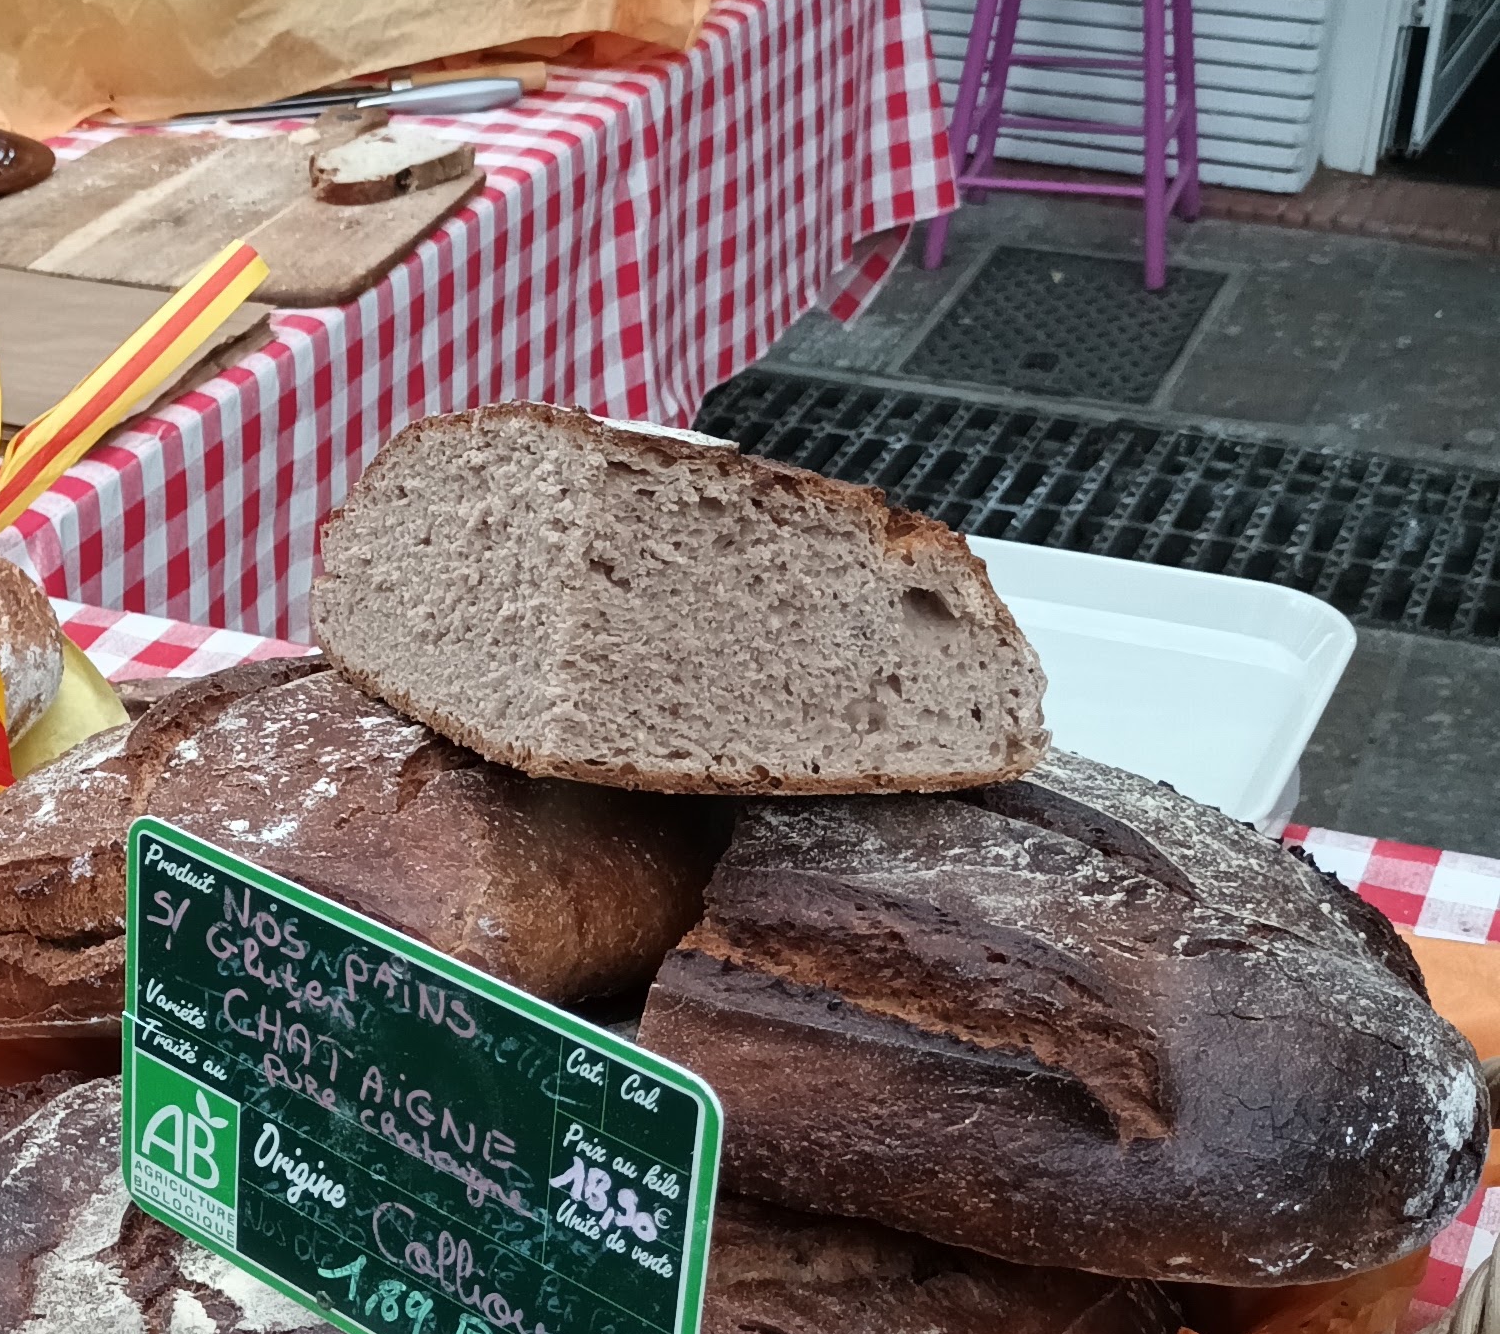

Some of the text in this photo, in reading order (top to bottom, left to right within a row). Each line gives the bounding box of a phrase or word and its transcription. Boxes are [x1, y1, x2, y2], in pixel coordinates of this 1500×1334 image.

[144, 842, 217, 894] Produit
[145, 977, 207, 1030] Variété
[203, 1059, 228, 1082] au
[566, 1048, 662, 1113] Cat. Cal.
[141, 1103, 220, 1189] AB
[253, 1122, 347, 1209] Origine
[562, 1122, 681, 1199] Prix au kilo
[134, 1158, 235, 1227] AGRICULTURE
[134, 1174, 235, 1244] BIOLOGIQUE
[654, 1207, 673, 1230] €
[605, 1229, 627, 1254] de
[631, 1245, 674, 1279] vente
